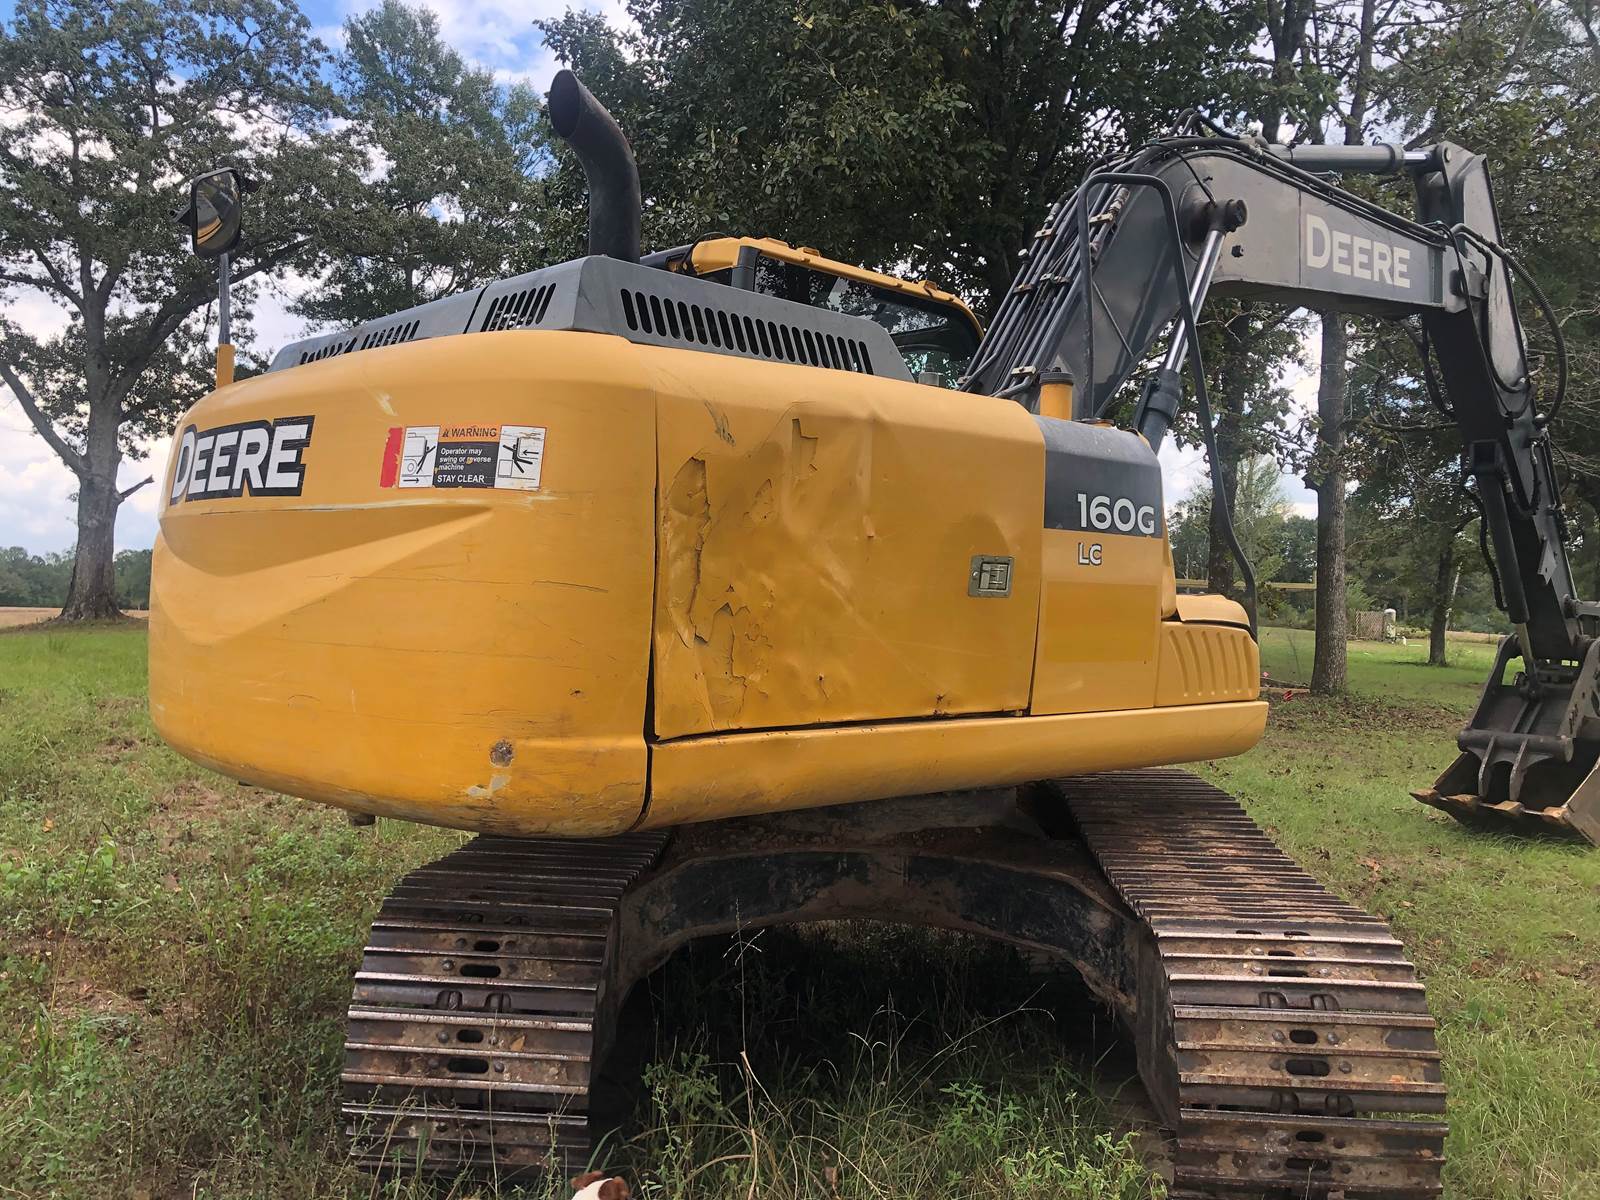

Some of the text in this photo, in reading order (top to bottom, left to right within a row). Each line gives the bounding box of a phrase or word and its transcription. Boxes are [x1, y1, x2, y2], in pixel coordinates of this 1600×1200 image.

[1306, 213, 1411, 289] DEERE
[451, 427, 497, 438] WARNING
[439, 456, 458, 464] swing
[440, 447, 483, 456] Operator may
[171, 422, 309, 501] DEERE
[437, 474, 485, 483] STAY CLEAR
[1077, 493, 1155, 535] 160G
[1078, 541, 1103, 566] LC
